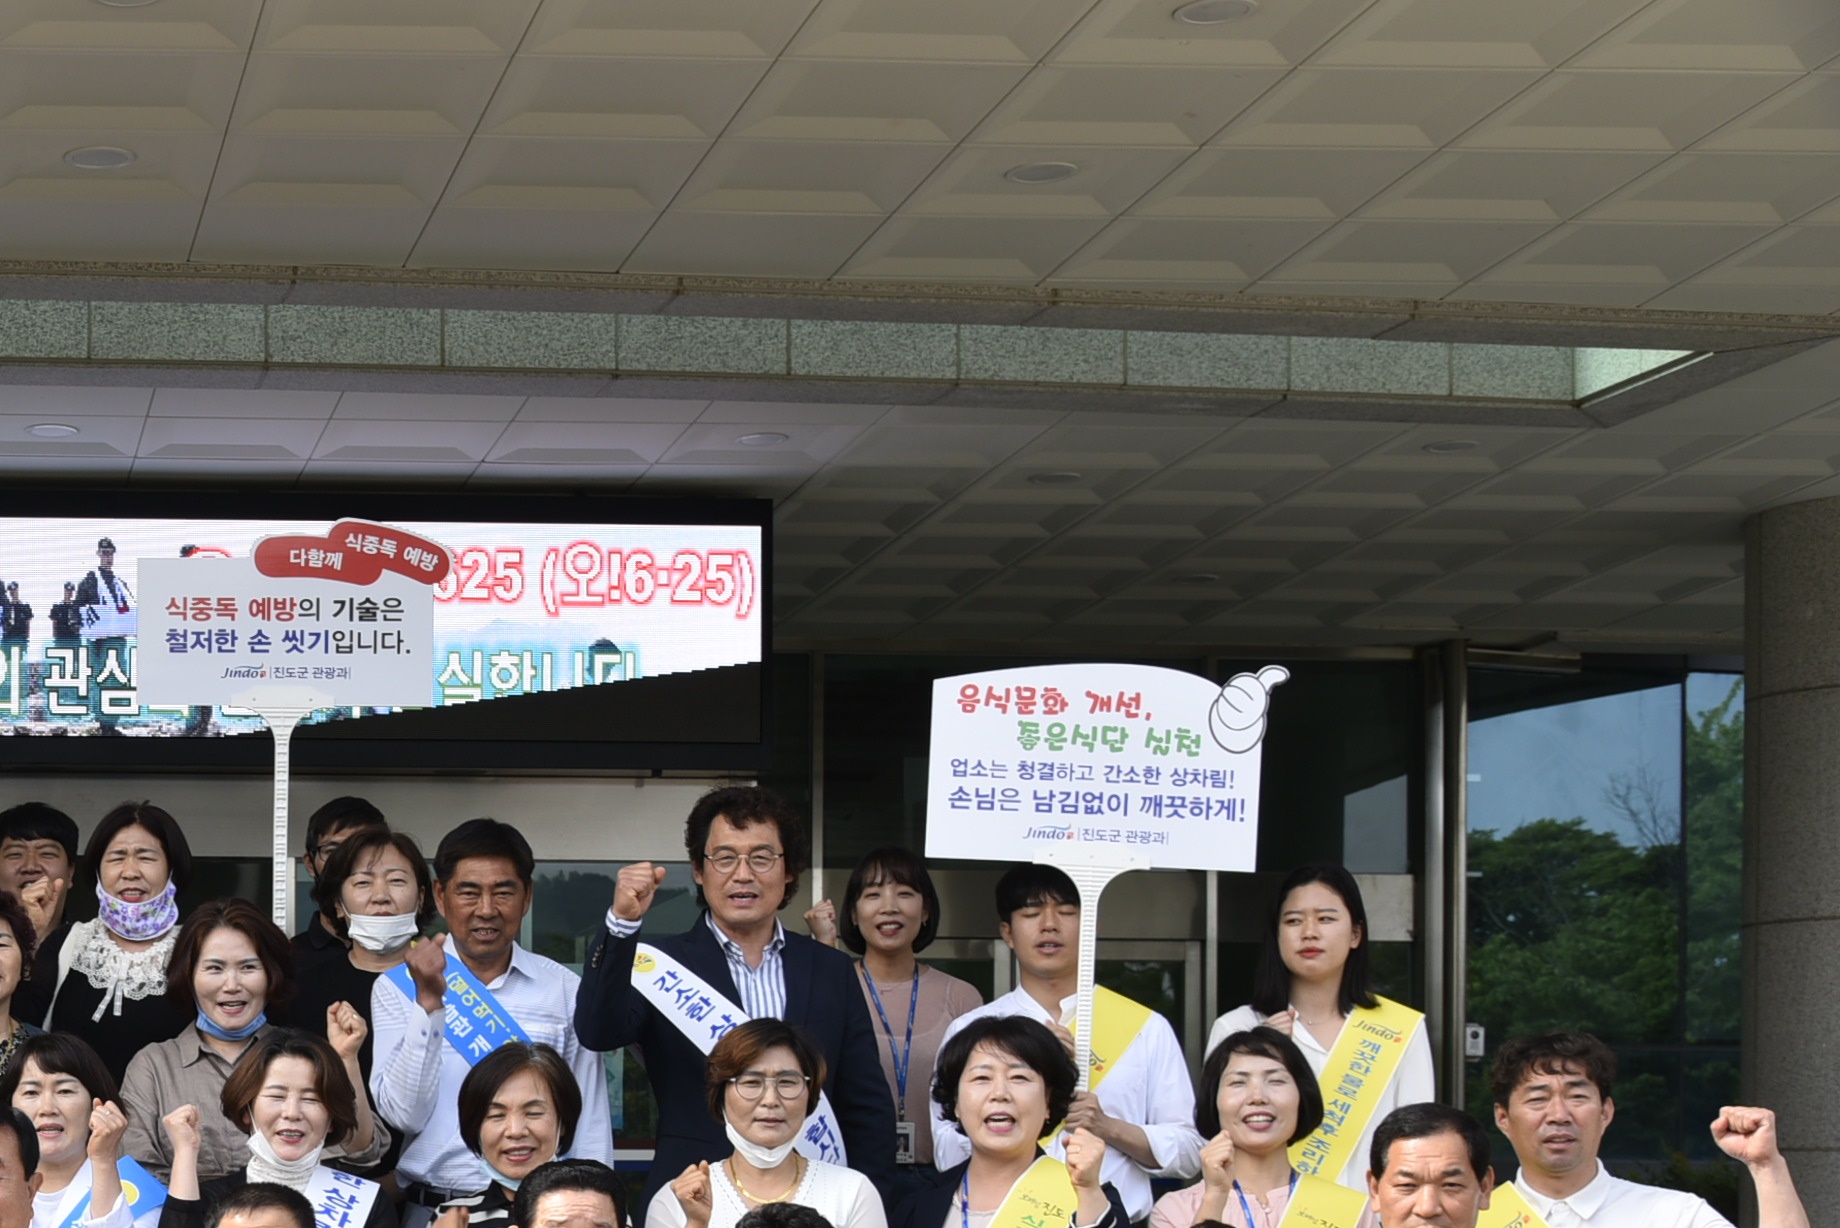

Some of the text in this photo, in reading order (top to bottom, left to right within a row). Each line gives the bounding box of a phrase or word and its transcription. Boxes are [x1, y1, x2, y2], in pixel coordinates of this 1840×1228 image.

[289, 549, 343, 571] 다함께
[344, 532, 439, 571] 식중독 예방
[165, 597, 405, 622] 식중독 예방의 기술은
[165, 629, 411, 655] 철저한 손 씻기입니다.
[273, 667, 308, 680] 진도군
[312, 667, 349, 680] 관광과
[957, 684, 1152, 721] 음식문화 개선,
[1017, 721, 1202, 757] 좋은식단 실천
[950, 758, 1235, 790] 업소는 청결하고 간소한 상차림!
[948, 786, 1246, 823] 손님은 남김없이 깨끗하게!
[1081, 828, 1122, 843] 진도군
[1125, 830, 1166, 846] 관광과
[653, 970, 716, 1023] 간소한
[1349, 1038, 1382, 1077] 깨끗한
[1337, 1073, 1365, 1102] 물로
